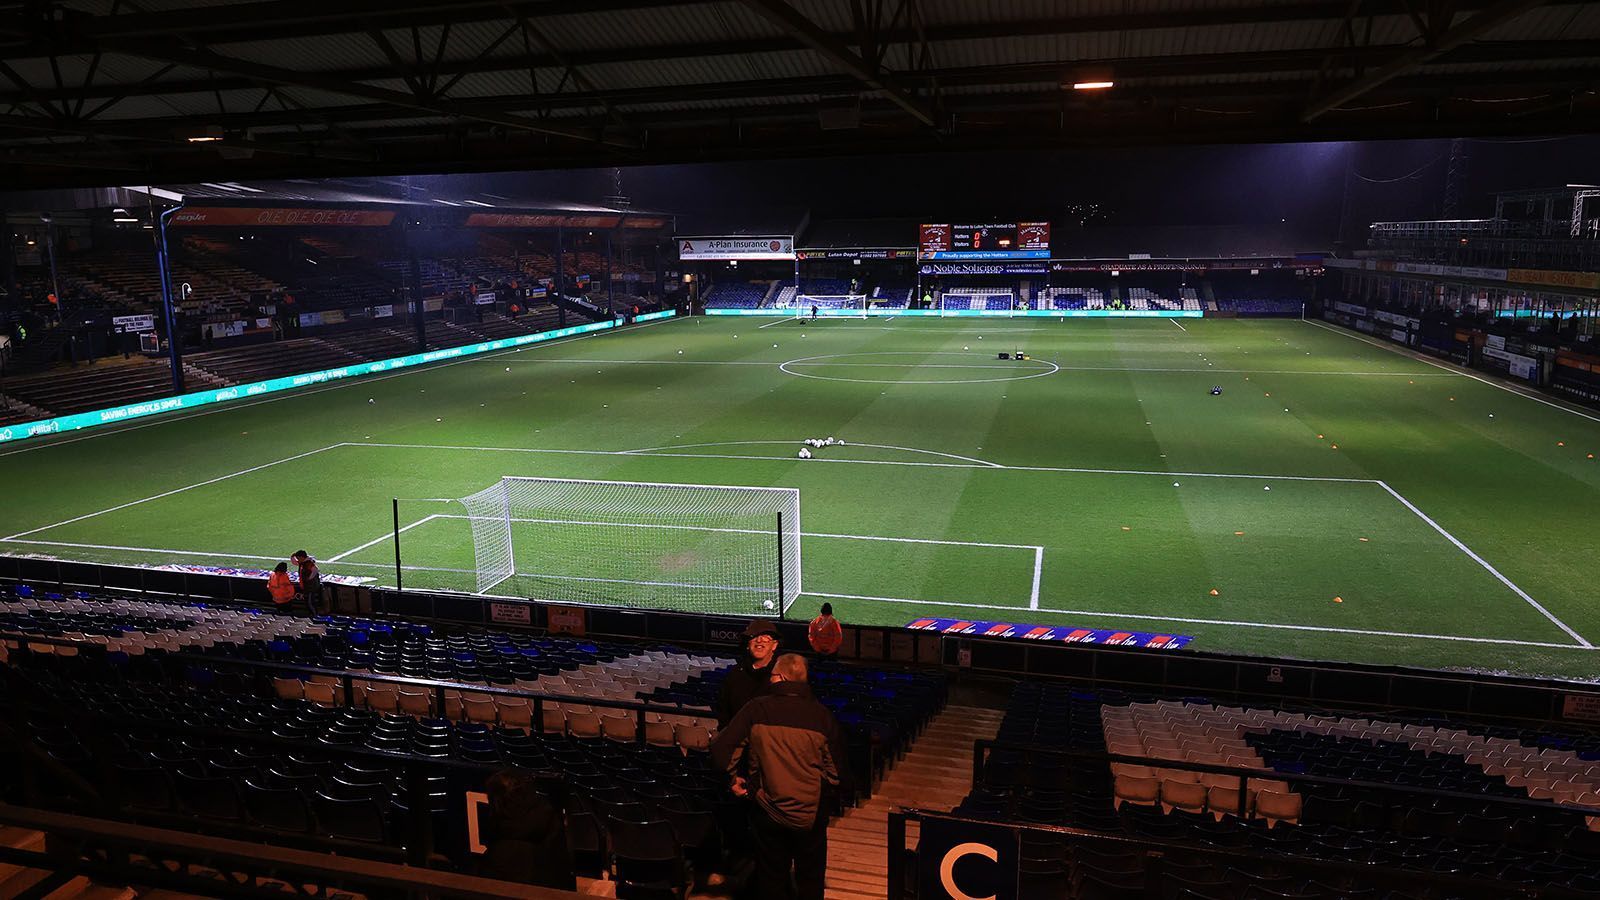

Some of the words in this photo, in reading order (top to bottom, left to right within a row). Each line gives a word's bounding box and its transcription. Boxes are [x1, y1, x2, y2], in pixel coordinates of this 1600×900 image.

[176, 213, 206, 223] easyJet
[974, 232, 980, 240] 0
[974, 240, 980, 248] 0
[933, 264, 961, 272] Noble
[962, 264, 1004, 272] Solicitors
[101, 409, 127, 422] SAVING
[127, 405, 152, 418] ENERGY
[160, 399, 183, 412] SIMPLE
[711, 629, 738, 641] BLOCK
[940, 842, 998, 900] C
